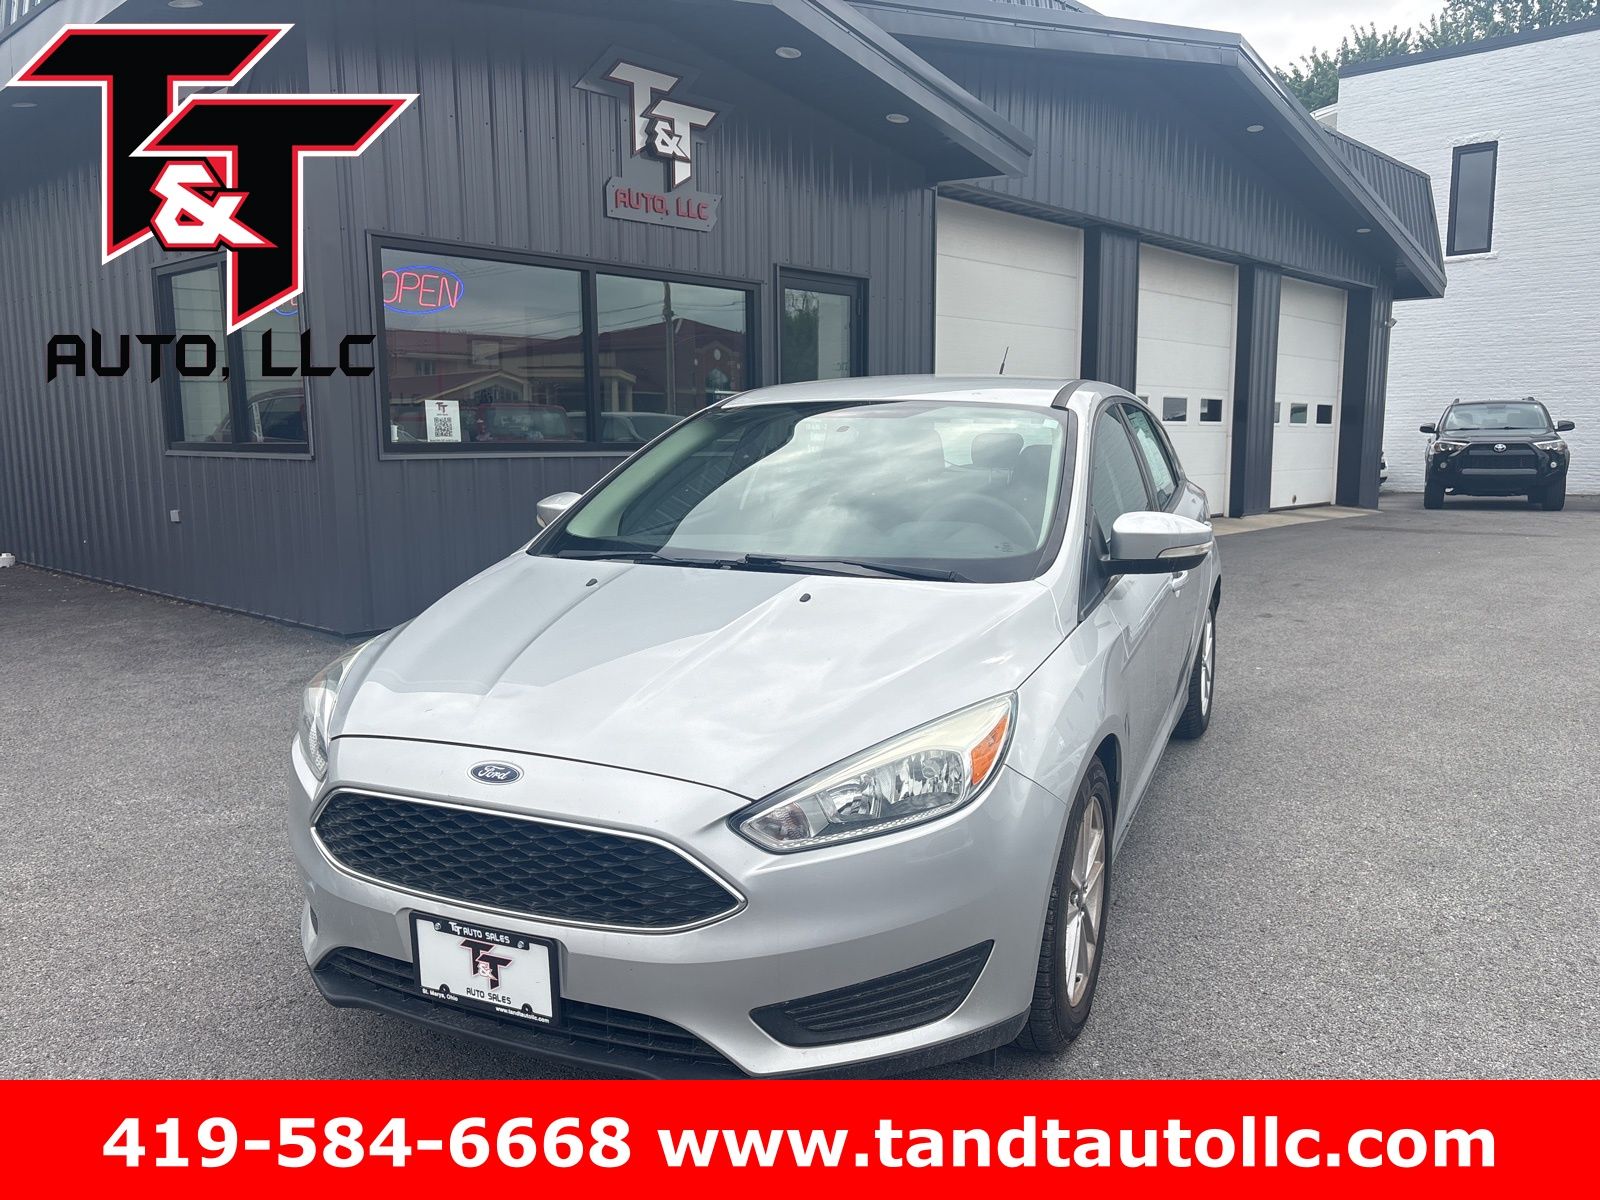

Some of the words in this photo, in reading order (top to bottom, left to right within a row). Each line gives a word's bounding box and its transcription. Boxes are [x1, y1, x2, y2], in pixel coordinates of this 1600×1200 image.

[675, 196, 710, 221] LLC
[381, 270, 459, 308] OPEN
[477, 765, 512, 781] Ford
[462, 927, 483, 939] AUTO
[485, 931, 511, 945] SALES
[466, 987, 485, 999] AUTO
[487, 992, 512, 1005] SALES
